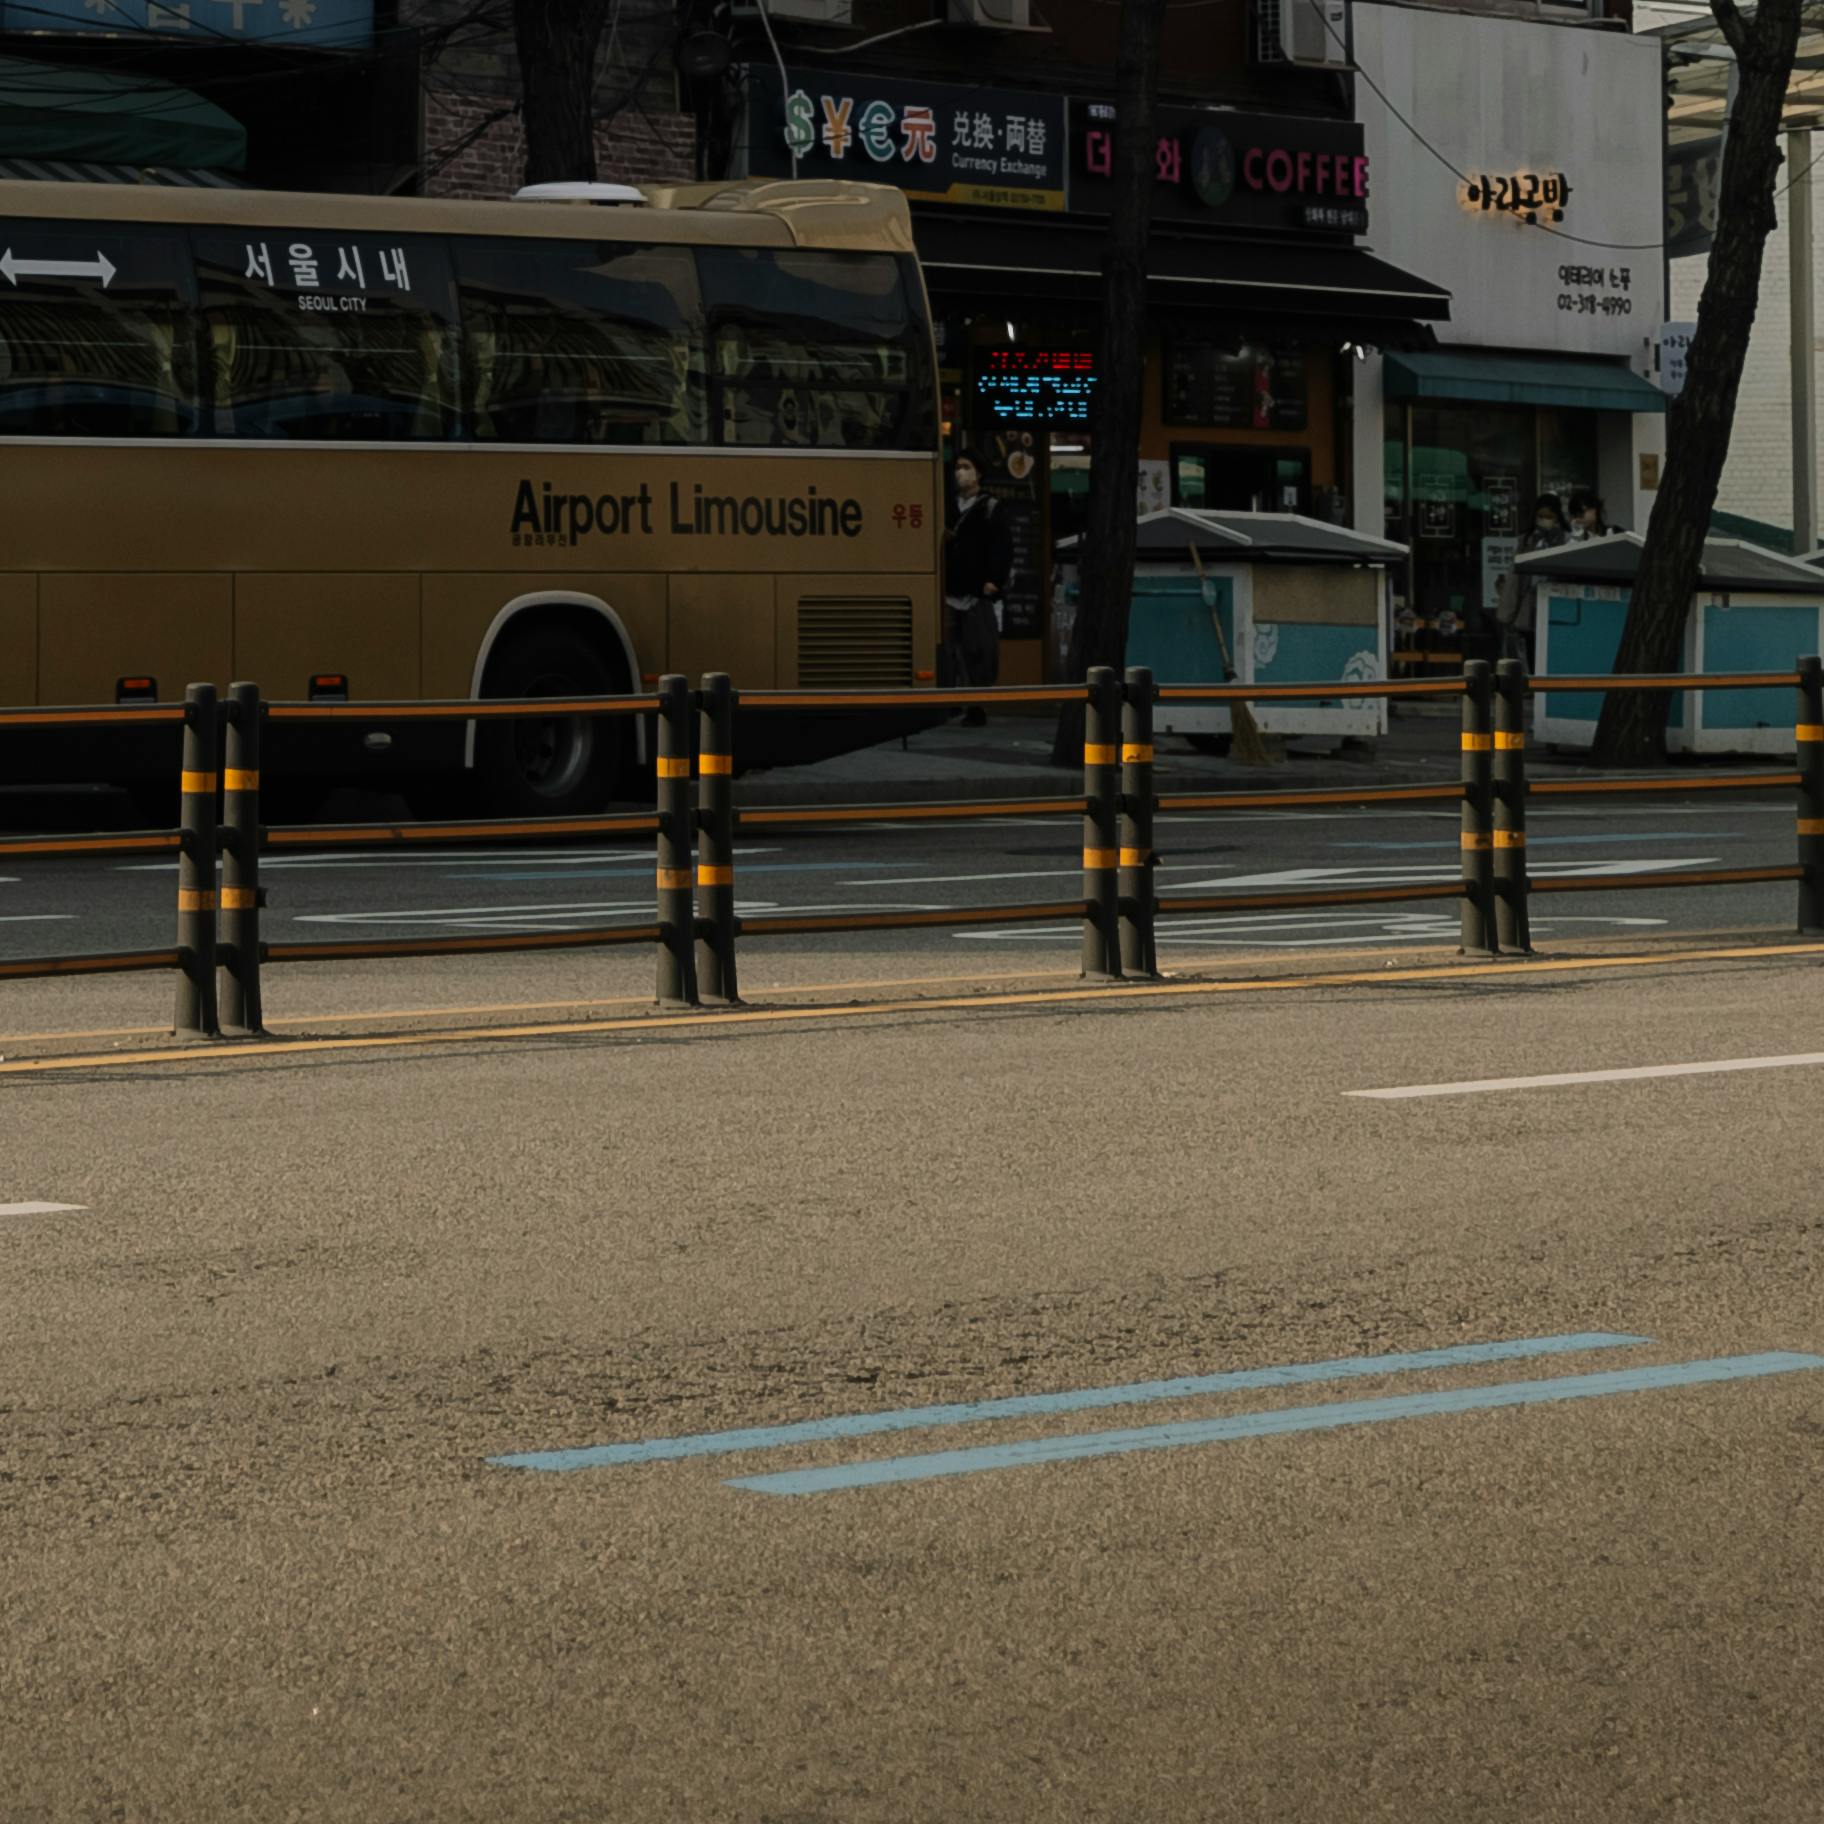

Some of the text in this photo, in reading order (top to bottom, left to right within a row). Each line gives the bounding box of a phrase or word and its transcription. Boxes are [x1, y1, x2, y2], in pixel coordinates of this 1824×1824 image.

[952, 153, 1047, 180] Currency Exchange
[1243, 147, 1369, 197] COFFEE
[1558, 265, 1604, 286] 인테리어
[297, 295, 367, 312] SEOUL CITY
[511, 480, 863, 546] Airport Limousine
[892, 503, 924, 529] 우등
